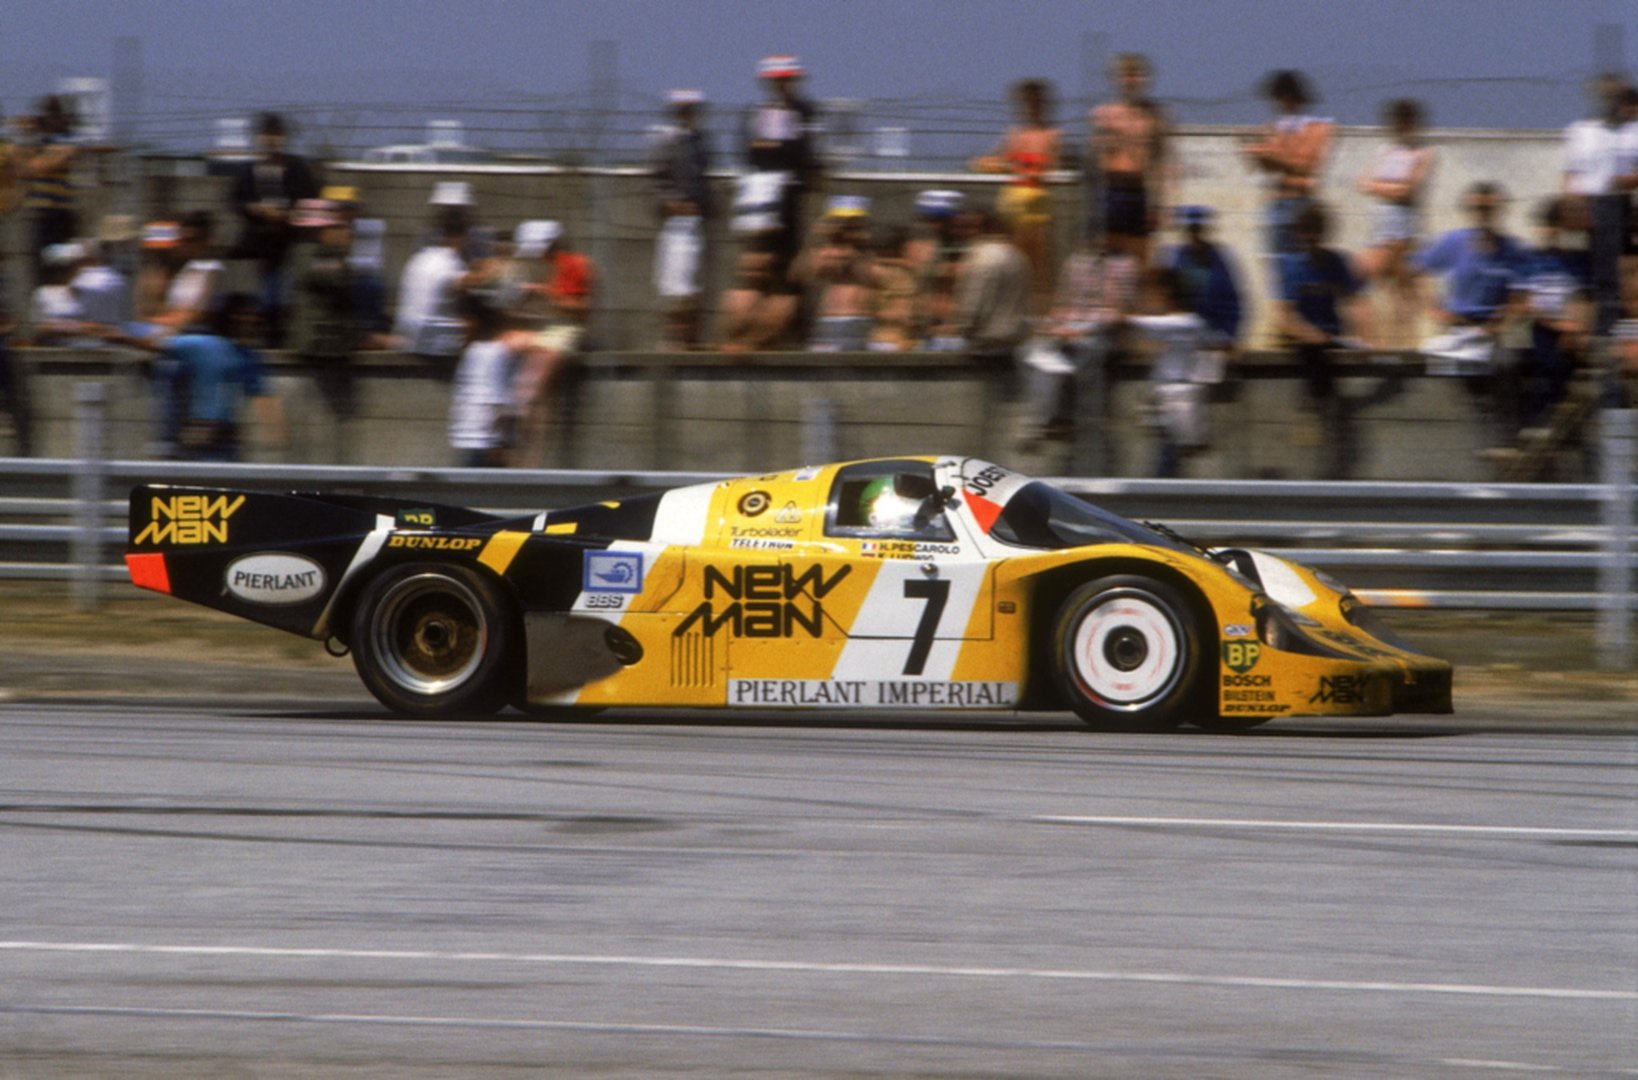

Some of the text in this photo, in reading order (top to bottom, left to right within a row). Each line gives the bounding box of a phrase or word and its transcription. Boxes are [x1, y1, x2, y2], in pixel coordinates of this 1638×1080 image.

[731, 526, 803, 537] Turbolader
[388, 535, 482, 550] DUNLOP
[233, 570, 318, 591] PIERLANT
[585, 594, 624, 608] BBS
[903, 579, 951, 676] 7
[1227, 643, 1260, 666] BP
[1223, 674, 1272, 687] BOSCH
[735, 680, 1011, 706] PIERLANT IMPERIAL
[1224, 690, 1275, 702] BILSTEIN
[1224, 704, 1291, 712] DUNLOP
